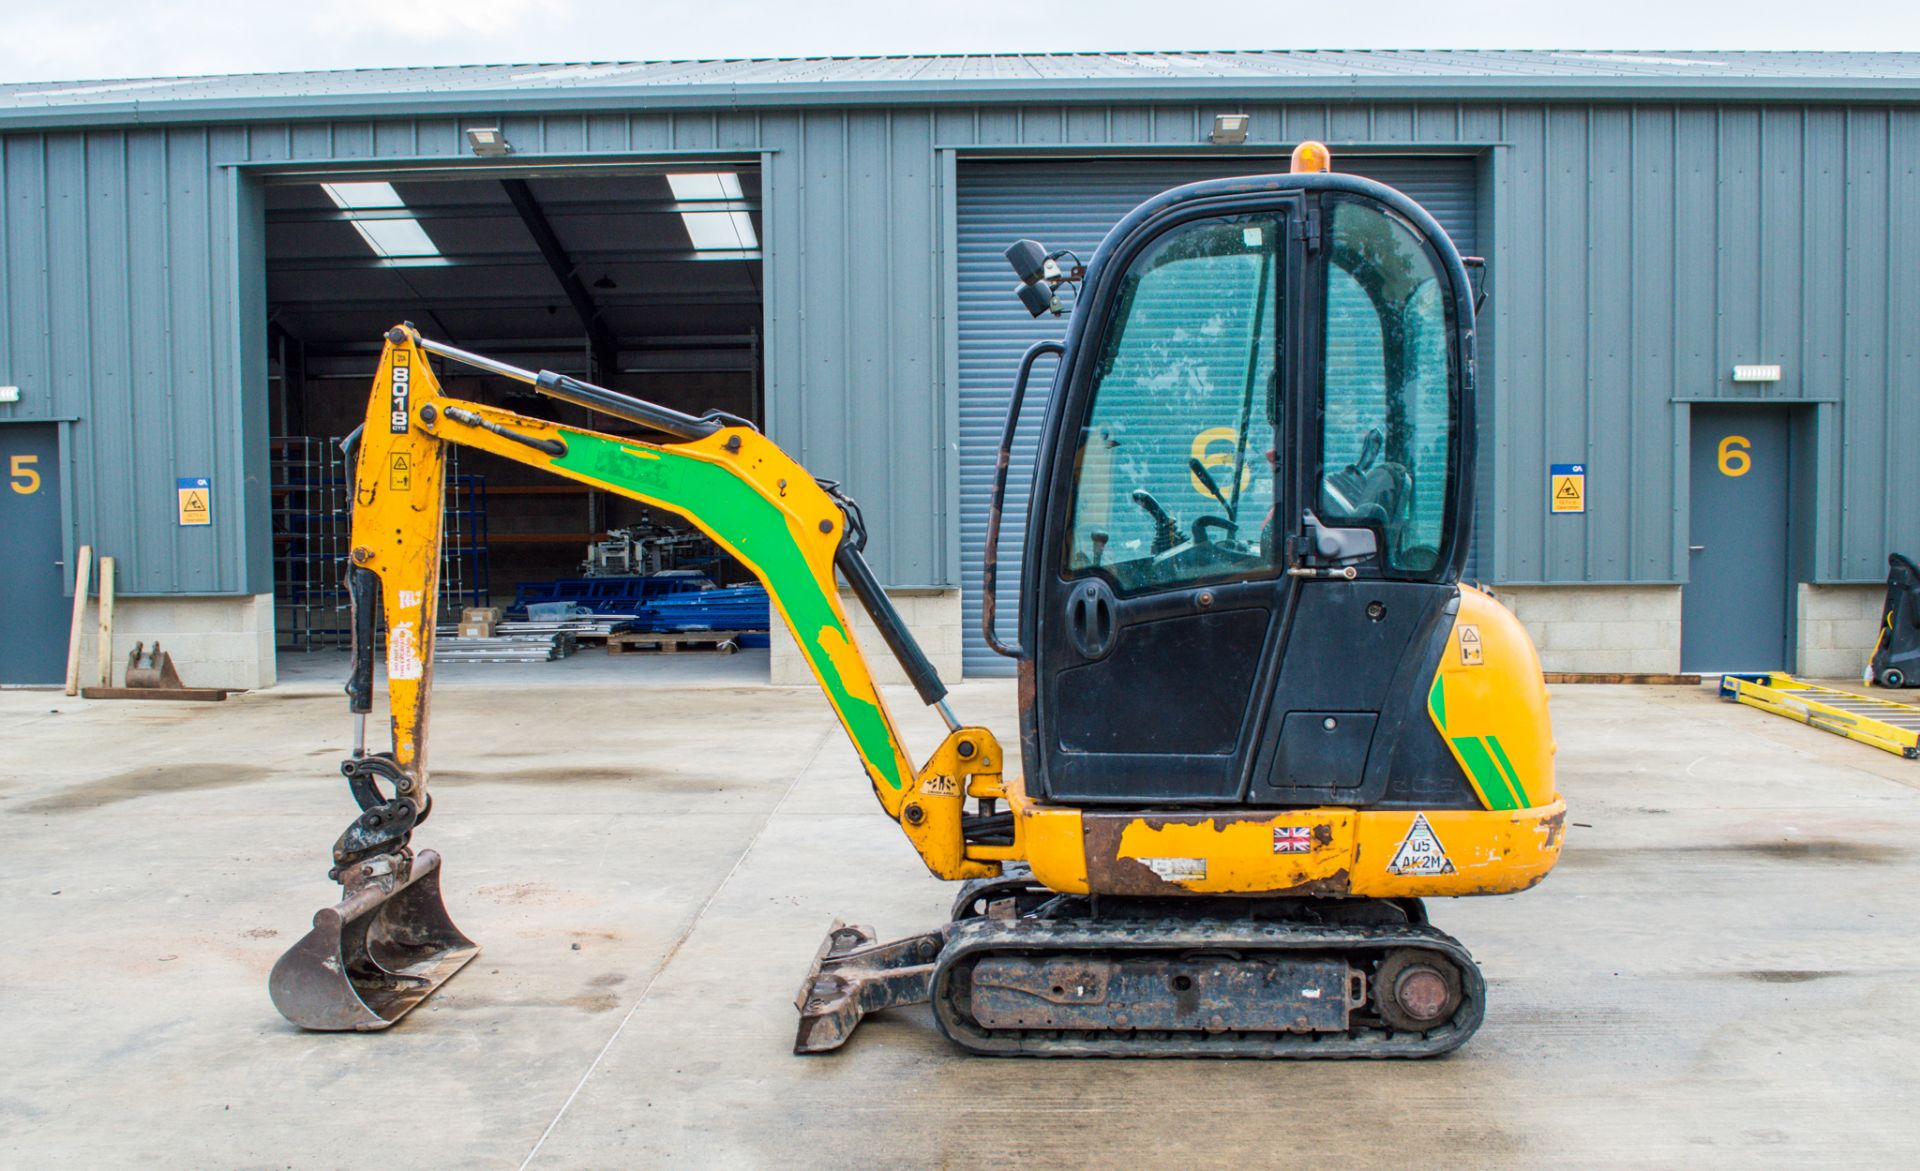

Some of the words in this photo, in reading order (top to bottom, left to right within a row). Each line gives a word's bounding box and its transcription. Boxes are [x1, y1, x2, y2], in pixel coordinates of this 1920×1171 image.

[392, 367, 409, 426] 8018
[10, 455, 41, 495] 5
[1718, 435, 1751, 477] 6
